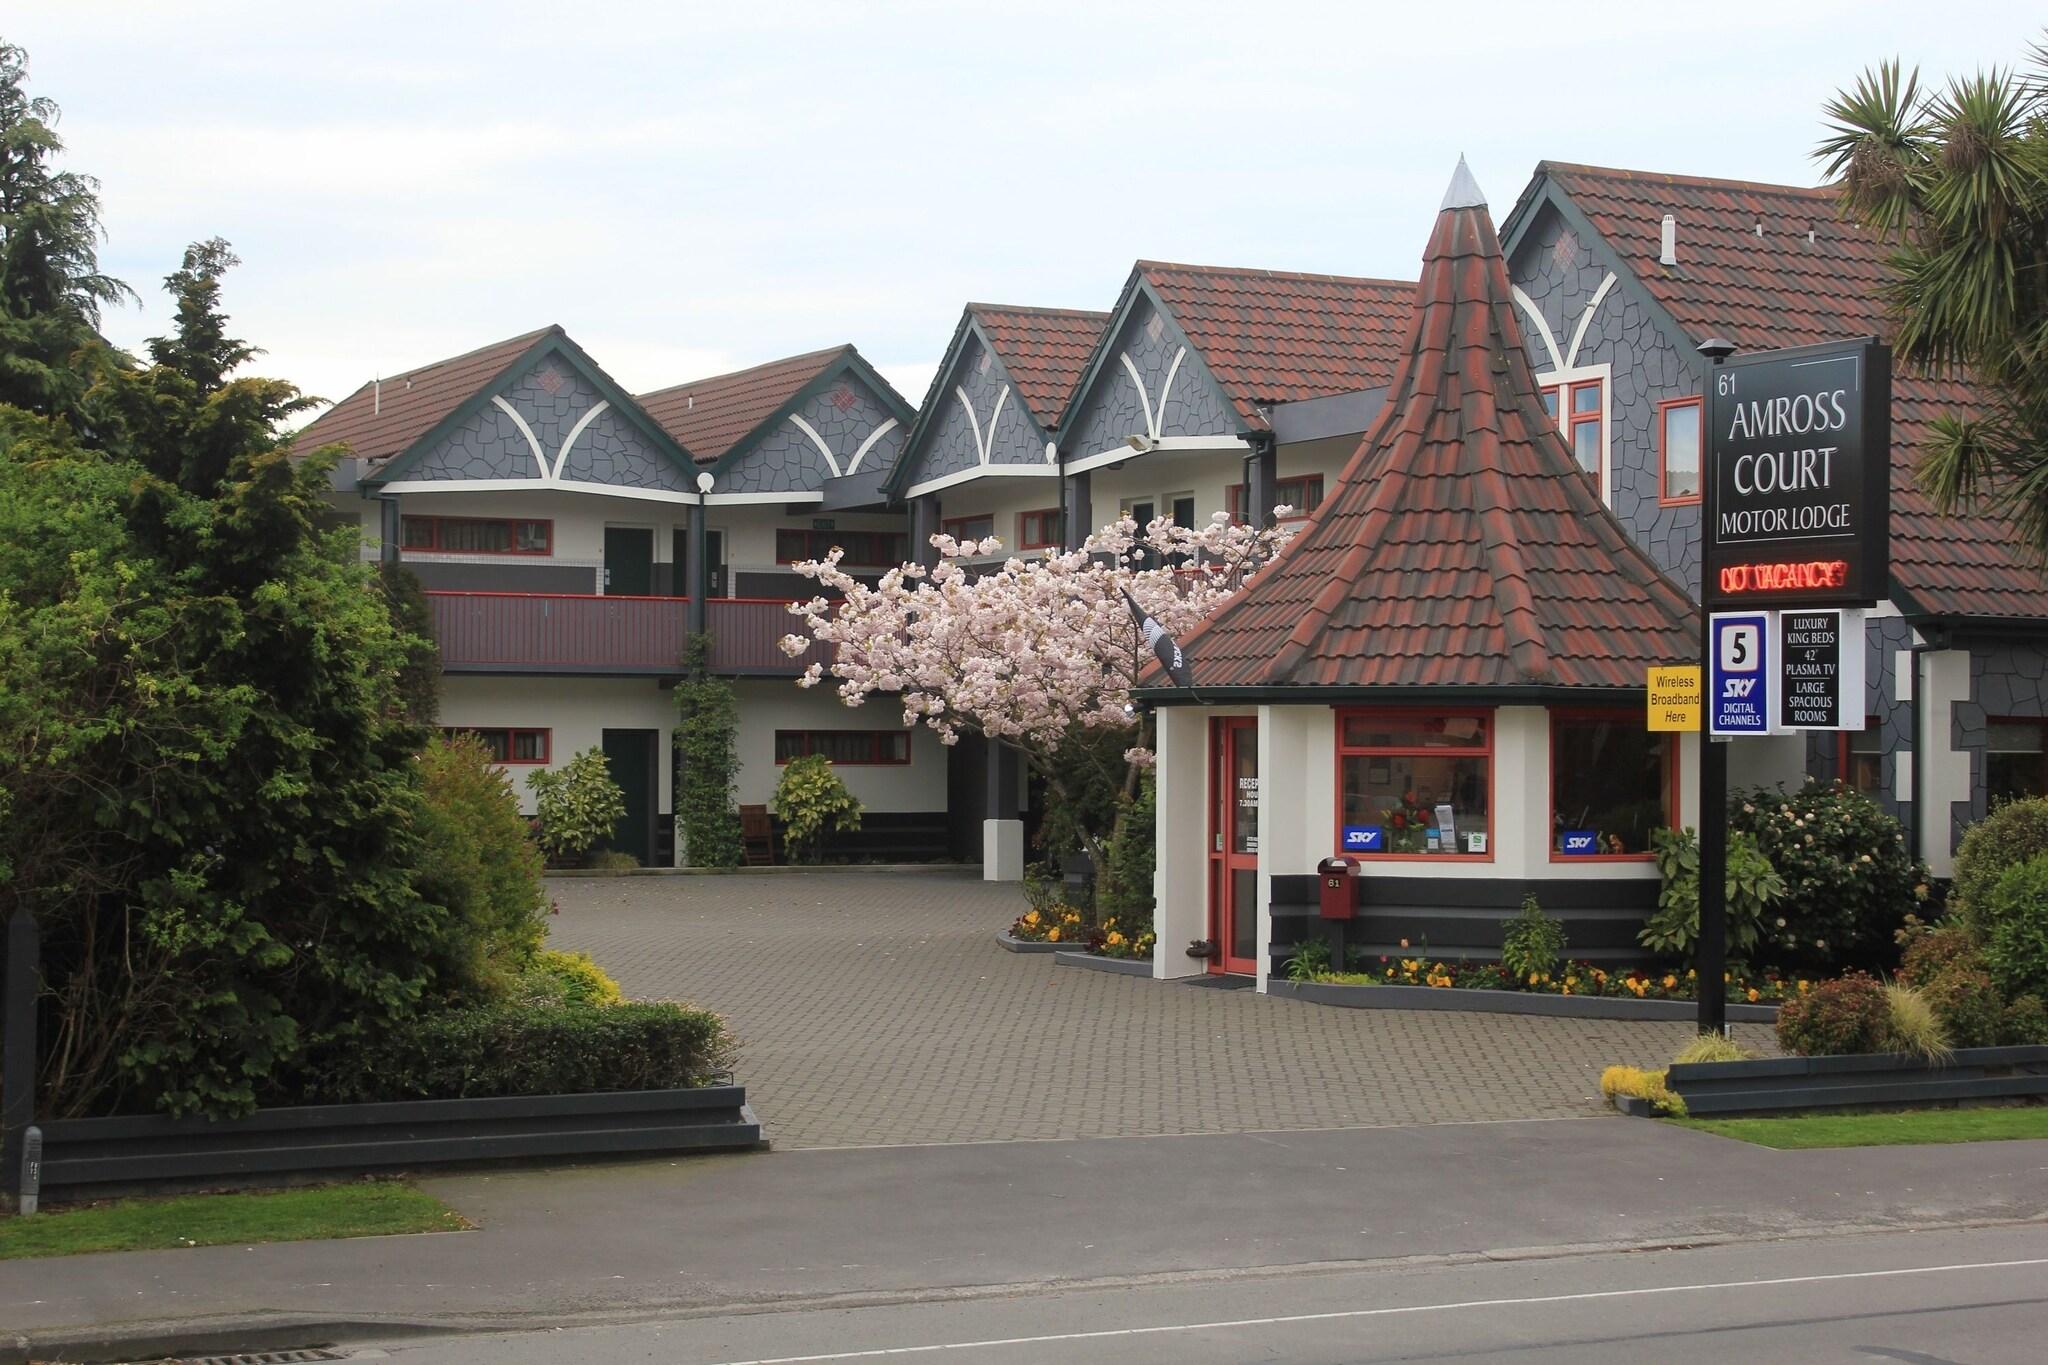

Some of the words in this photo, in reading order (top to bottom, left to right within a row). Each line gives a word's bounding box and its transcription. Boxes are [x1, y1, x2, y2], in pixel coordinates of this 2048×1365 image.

[1718, 372, 1736, 396] 61
[1728, 389, 1846, 441] AMROSS
[1734, 447, 1839, 496] COURT
[1721, 508, 1788, 535] MOTOR
[1792, 503, 1851, 530] LODGE
[1755, 560, 1846, 591] VACANCY
[1793, 617, 1829, 630] LUXURY
[1787, 632, 1810, 644] KING
[1811, 631, 1835, 644] BEDS
[1732, 632, 1747, 664] 5
[1786, 663, 1822, 676] PLASMA
[1823, 663, 1836, 675] TV
[1656, 675, 1695, 688] Wireless
[1722, 678, 1757, 698] SKY
[1796, 681, 1825, 694] LARGE
[1651, 692, 1700, 706] Broadband
[1789, 695, 1833, 708] SPACIOUS
[1723, 702, 1756, 714] DIGITAL
[1664, 710, 1687, 723] Here
[1718, 714, 1761, 726] CHANNELS
[1794, 710, 1828, 722] ROOMS
[1347, 832, 1377, 843] SKY
[1566, 837, 1592, 848] SKY
